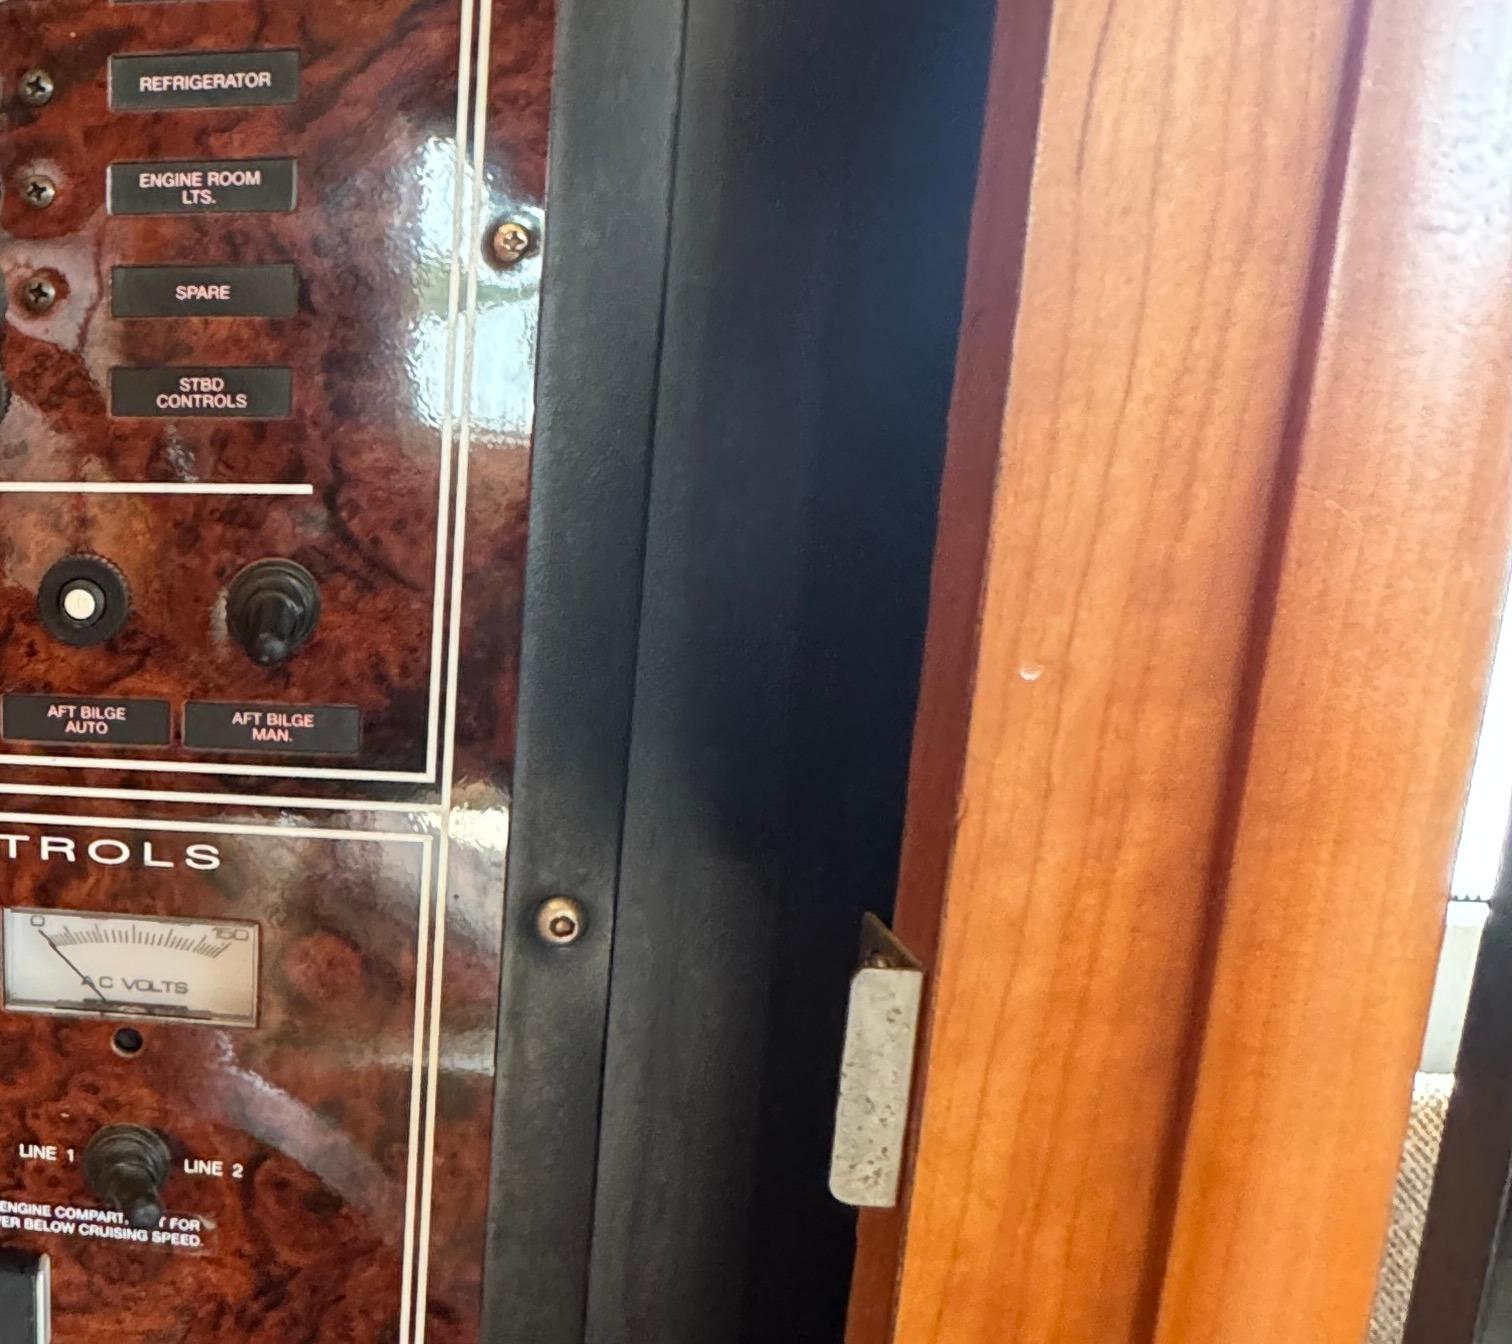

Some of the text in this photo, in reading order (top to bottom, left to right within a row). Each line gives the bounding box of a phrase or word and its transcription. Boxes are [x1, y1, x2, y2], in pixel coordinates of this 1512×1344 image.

[139, 72, 271, 92] REFRIGERATOR
[138, 170, 260, 188] ENGINE ROOM
[182, 189, 216, 205] LTS.
[175, 286, 231, 300] SPARE
[179, 377, 224, 392] STBD
[156, 394, 247, 409] CONTROLS
[48, 704, 126, 721] AFT BILGE
[231, 711, 314, 728] AFT BILGE
[65, 719, 109, 735] AUTO
[252, 727, 293, 742] MAN.
[121, 978, 188, 994] VOLTS
[19, 1143, 74, 1162] LINE 1
[183, 1159, 244, 1178] LINE 2
[24, 1217, 75, 1235] BELOW
[79, 1222, 148, 1242] CRUISING
[151, 1229, 205, 1248] SPEED.
[169, 1217, 200, 1232] FOR
